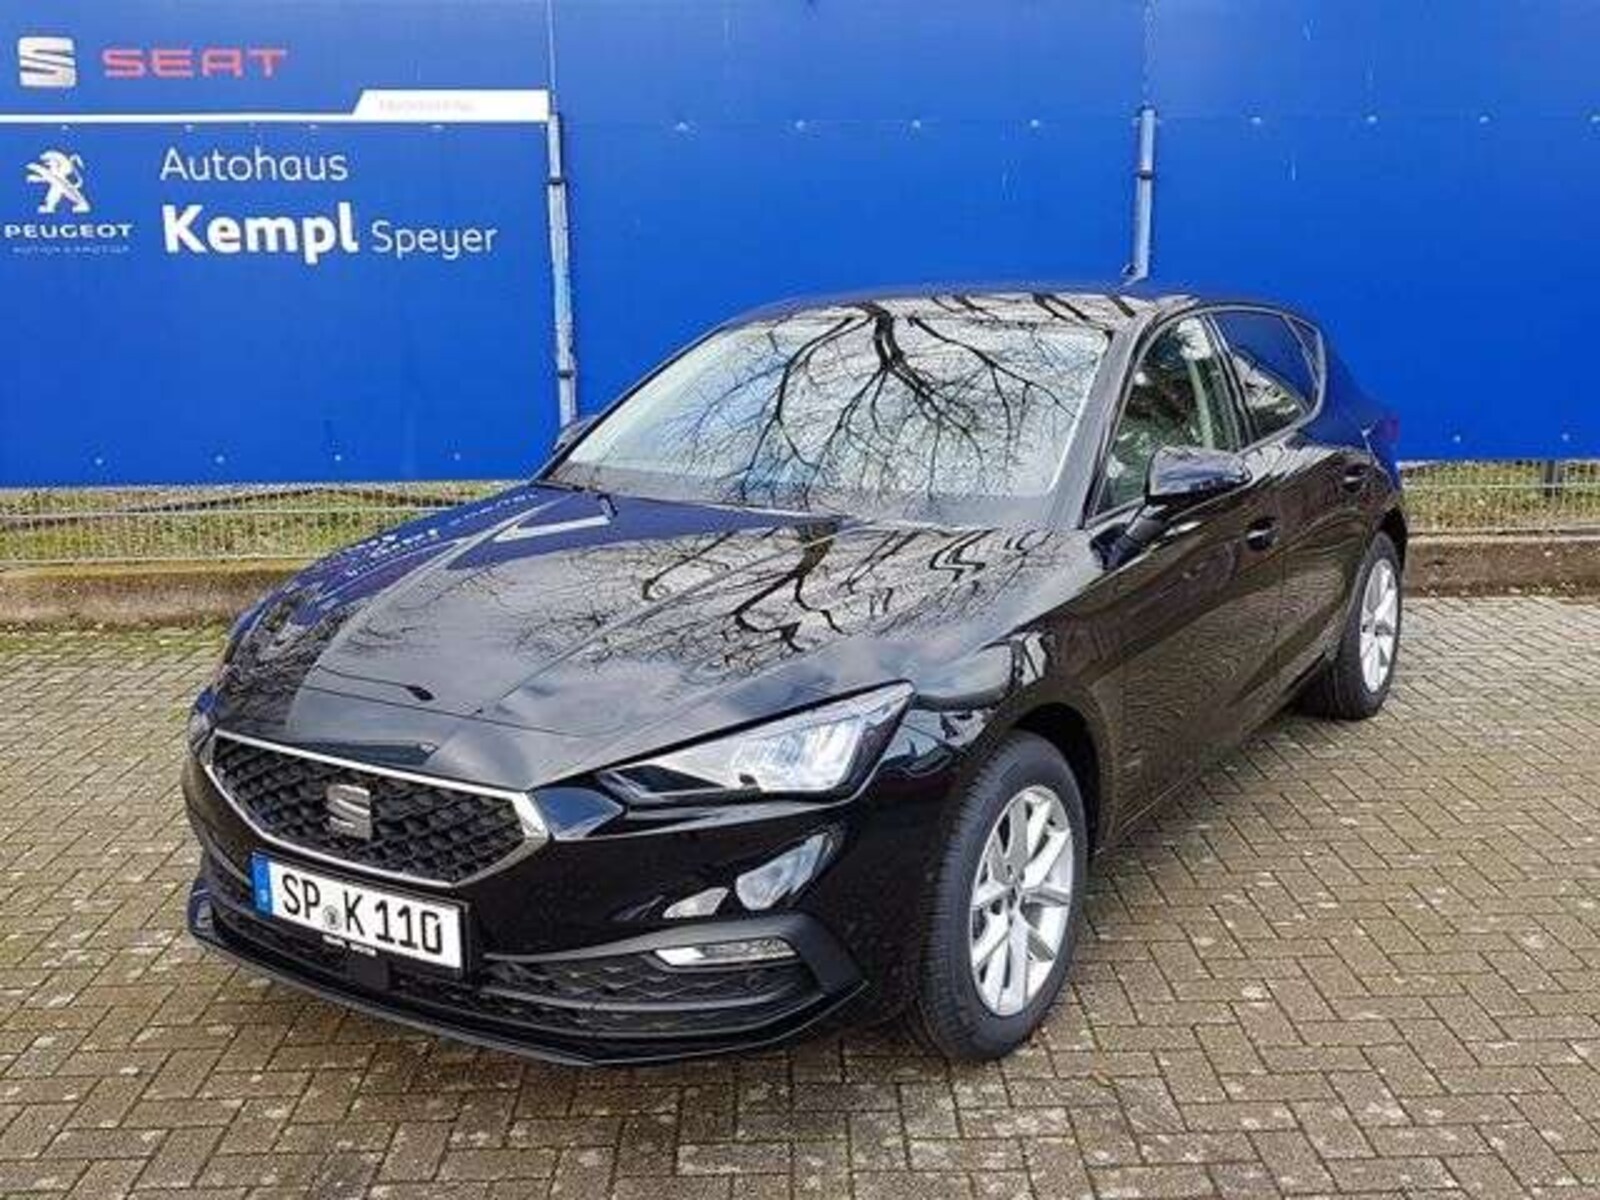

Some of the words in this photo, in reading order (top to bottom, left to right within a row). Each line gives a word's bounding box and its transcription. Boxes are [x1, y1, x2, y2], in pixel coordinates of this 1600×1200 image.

[102, 48, 288, 78] SEAT
[160, 147, 349, 182] Autohaus
[4, 224, 133, 238] PEUGEOT
[161, 203, 359, 265] Kempl
[370, 220, 499, 263] Speyer
[282, 873, 321, 920] SP
